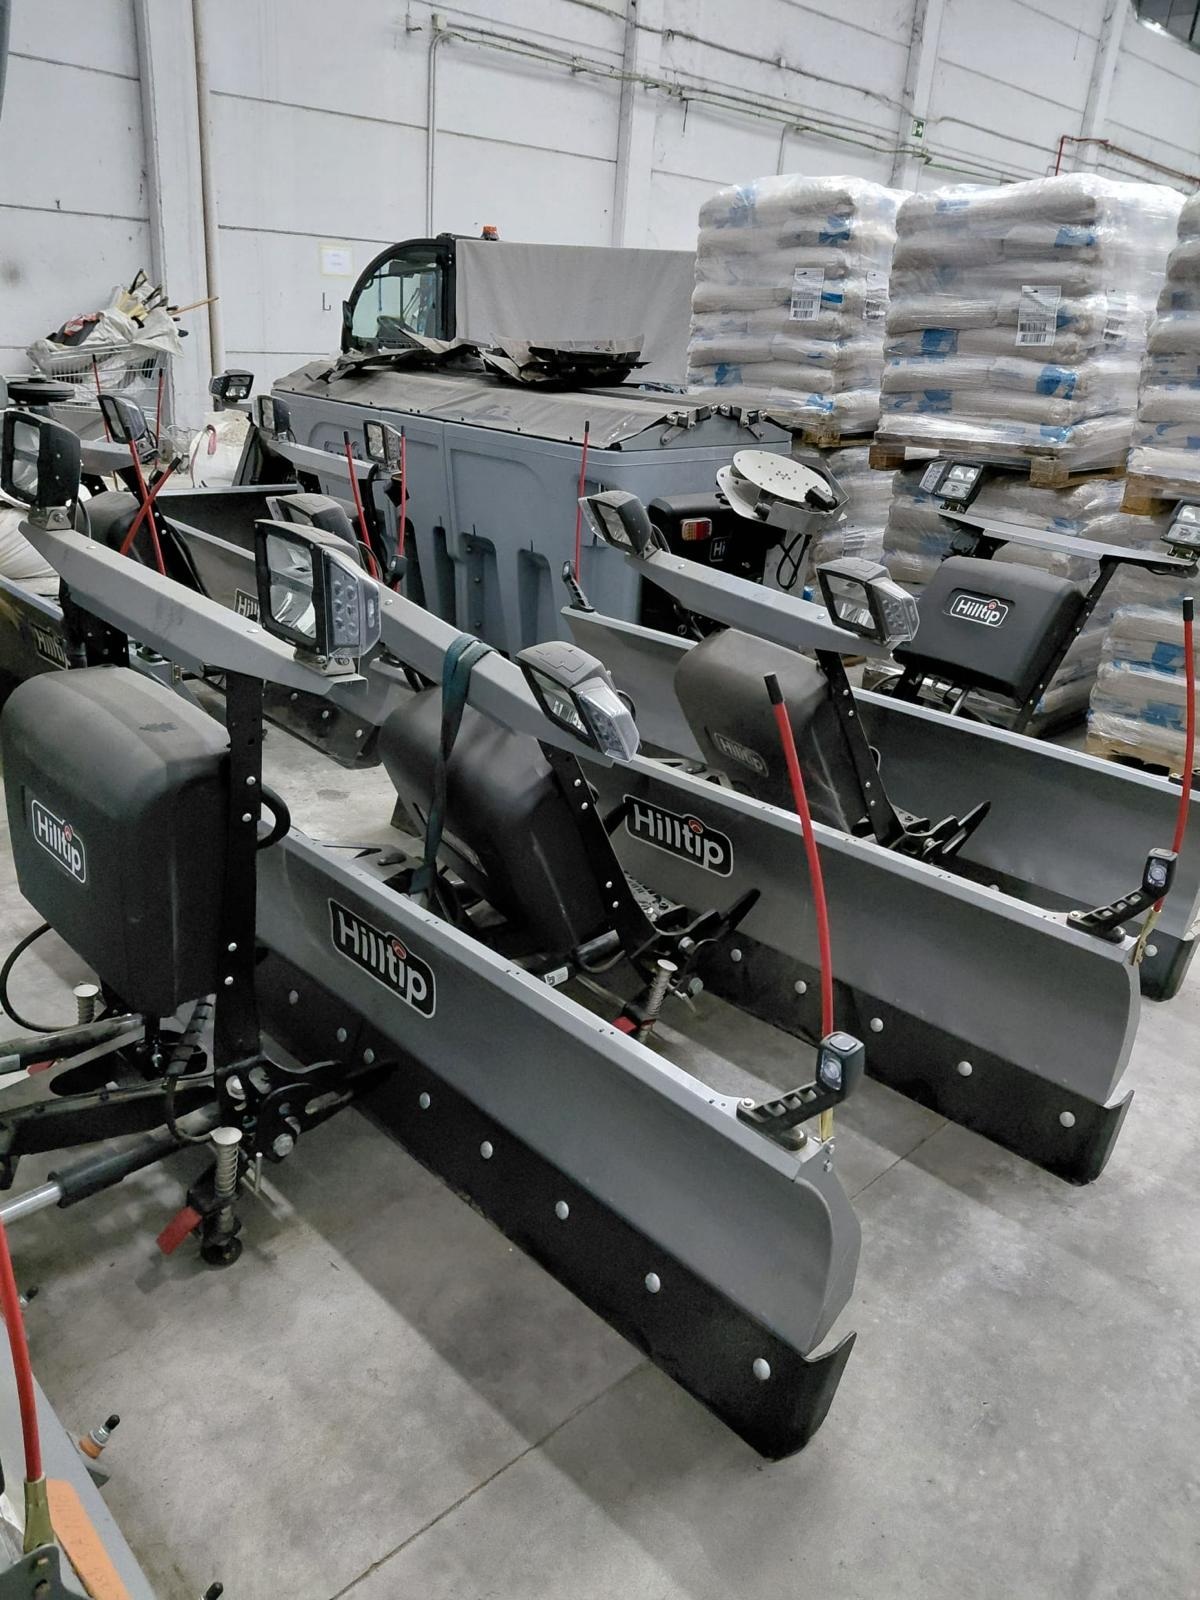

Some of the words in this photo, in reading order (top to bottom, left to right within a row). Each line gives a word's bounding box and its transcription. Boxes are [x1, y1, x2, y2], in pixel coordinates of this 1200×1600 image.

[956, 599, 1000, 624] Hilltip
[37, 809, 81, 873] Hilltip
[633, 803, 724, 869] Hilltip
[338, 910, 427, 1004] Hilltip
